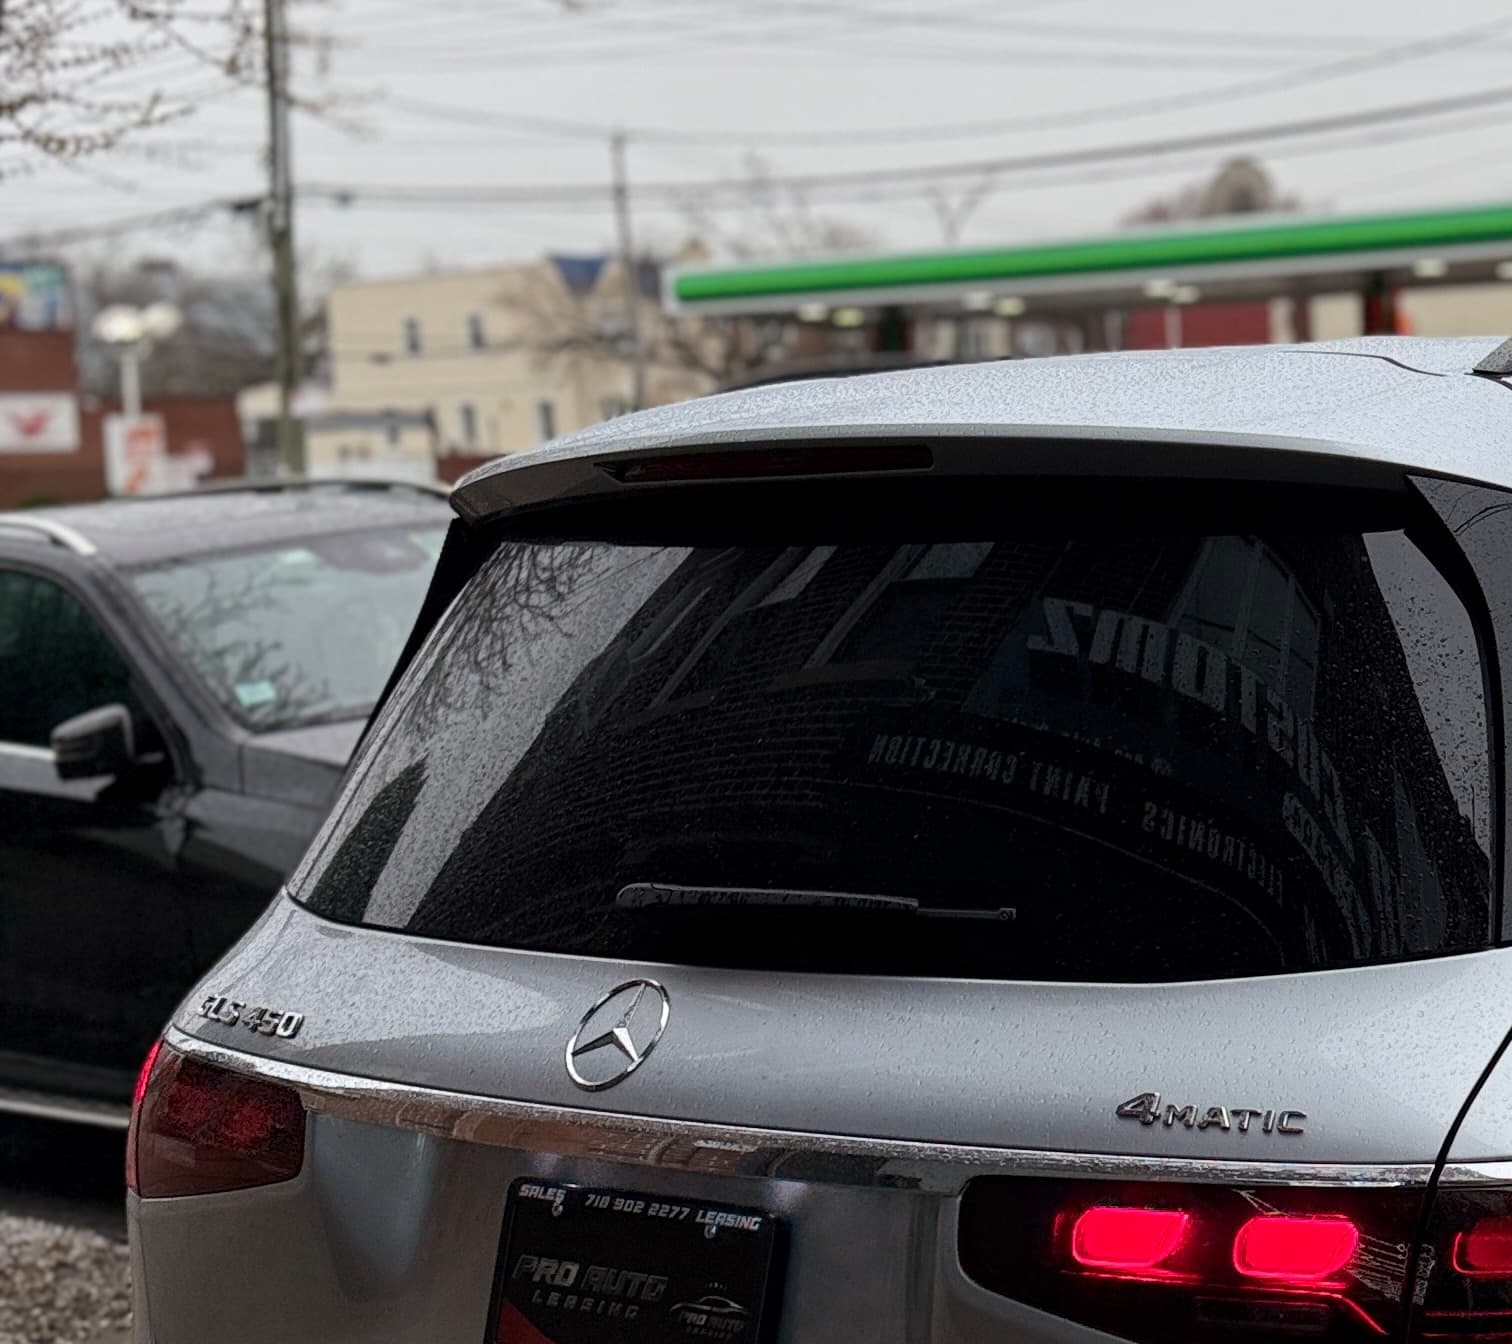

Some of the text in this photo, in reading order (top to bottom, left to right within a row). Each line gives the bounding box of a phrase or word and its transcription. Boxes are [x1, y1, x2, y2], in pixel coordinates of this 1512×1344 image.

[241, 1007, 305, 1039] 450
[1116, 1091, 1307, 1134] 4MATIC
[519, 1184, 762, 1231] SALES 718 902 2277 LEASING
[512, 1254, 669, 1302] PRO AUTO
[532, 1289, 640, 1320] LEASING
